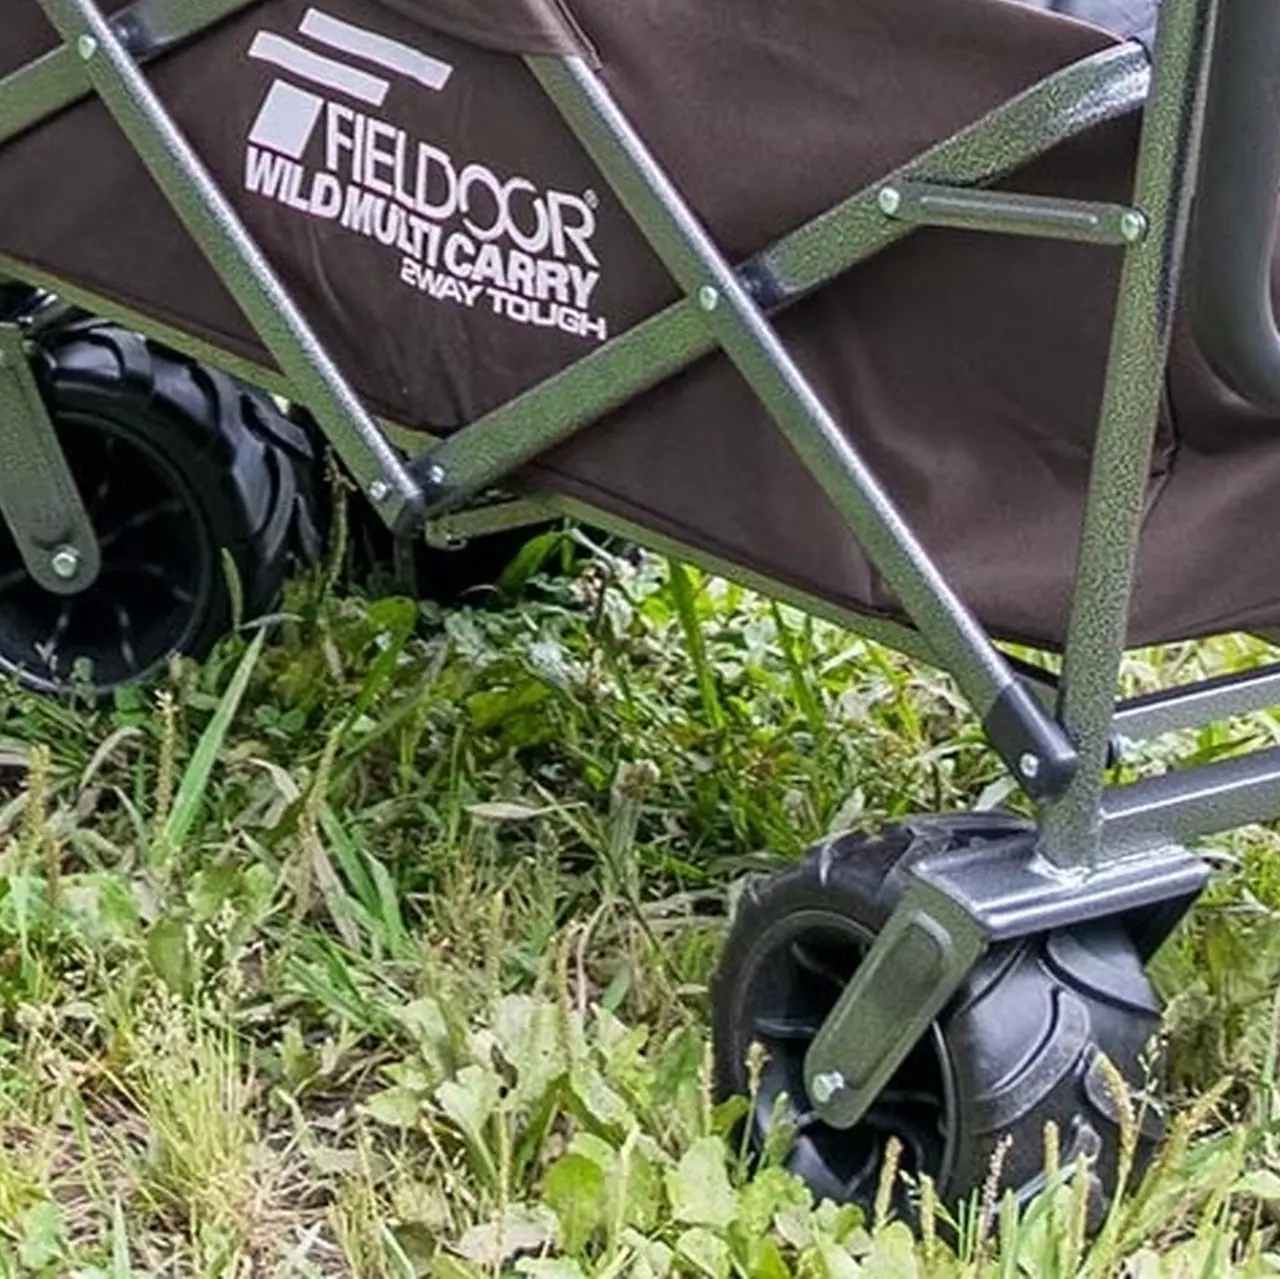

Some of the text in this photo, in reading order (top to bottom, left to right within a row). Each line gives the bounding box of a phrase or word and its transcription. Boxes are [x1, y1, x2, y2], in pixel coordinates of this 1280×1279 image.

[245, 146, 599, 309] WILD MULTI CARRY
[325, 99, 600, 266] FIELDOOR
[400, 261, 607, 341] 2WAY TOUGH
